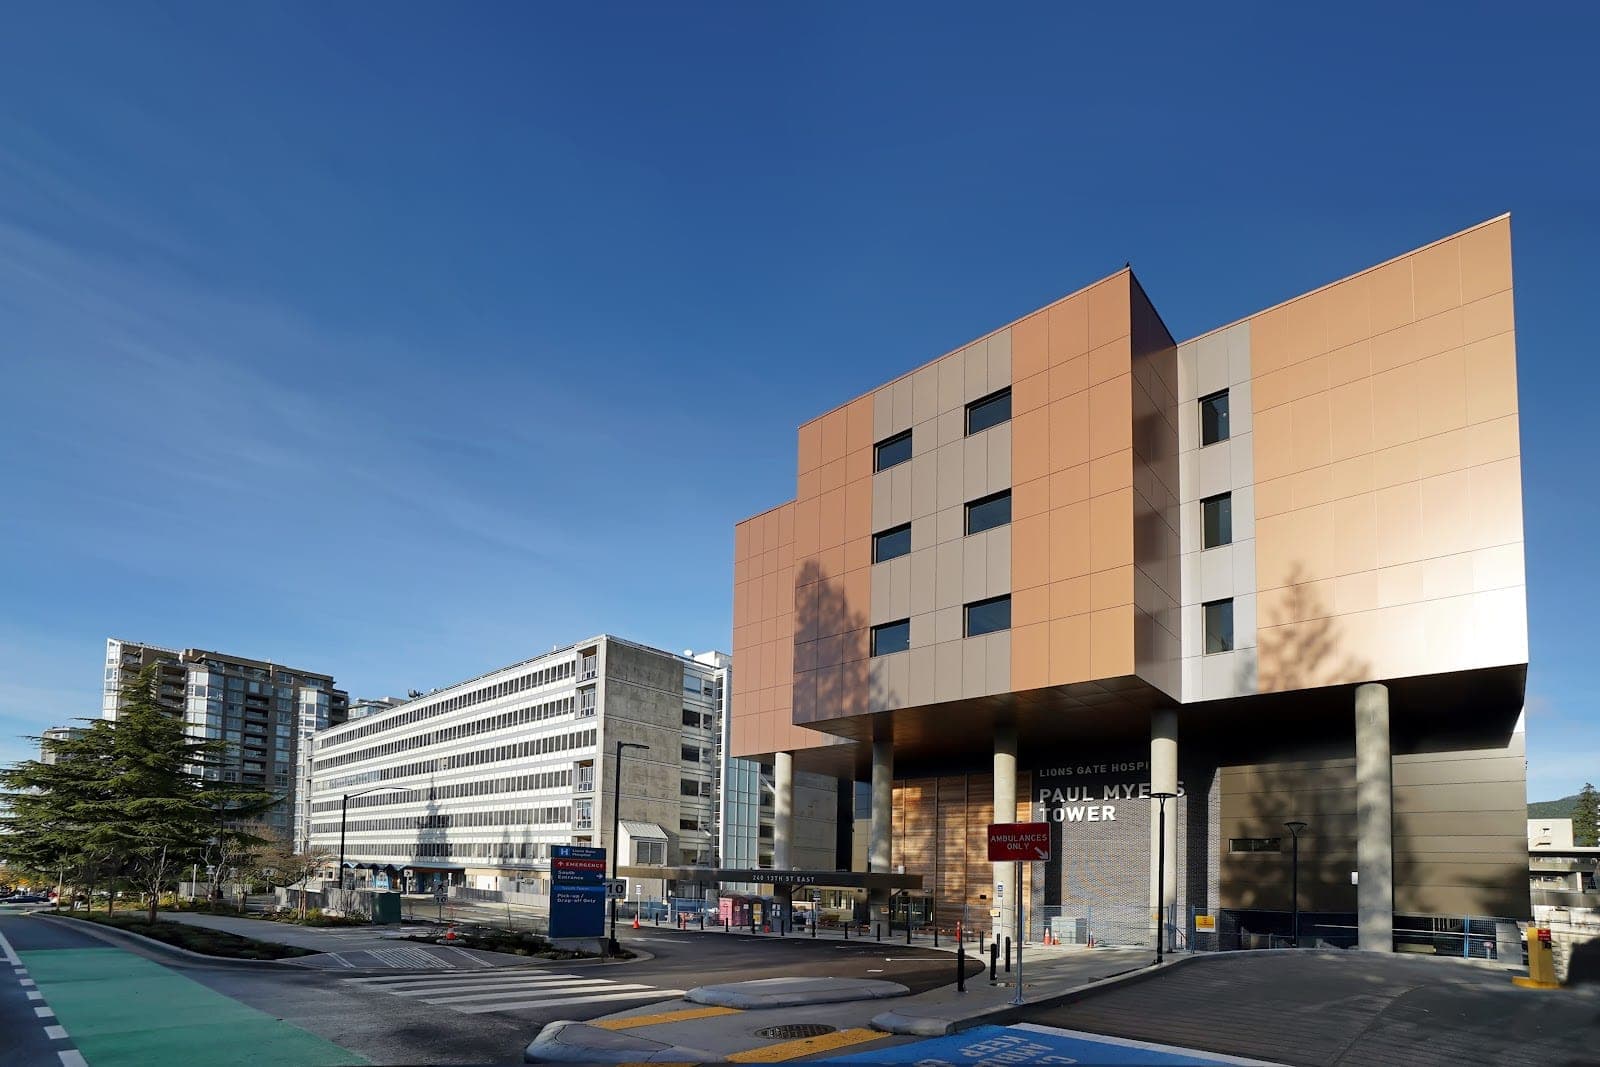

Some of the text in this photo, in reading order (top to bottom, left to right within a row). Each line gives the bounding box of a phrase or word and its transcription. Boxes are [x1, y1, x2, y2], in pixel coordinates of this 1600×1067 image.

[1039, 761, 1150, 777] LIONS GATE HOSPI
[1039, 781, 1185, 803] PAUL MYES
[1039, 805, 1116, 822] TOWER
[991, 833, 1048, 842] AMBULANCES
[1007, 842, 1030, 850] ONLY
[607, 884, 624, 894] 10
